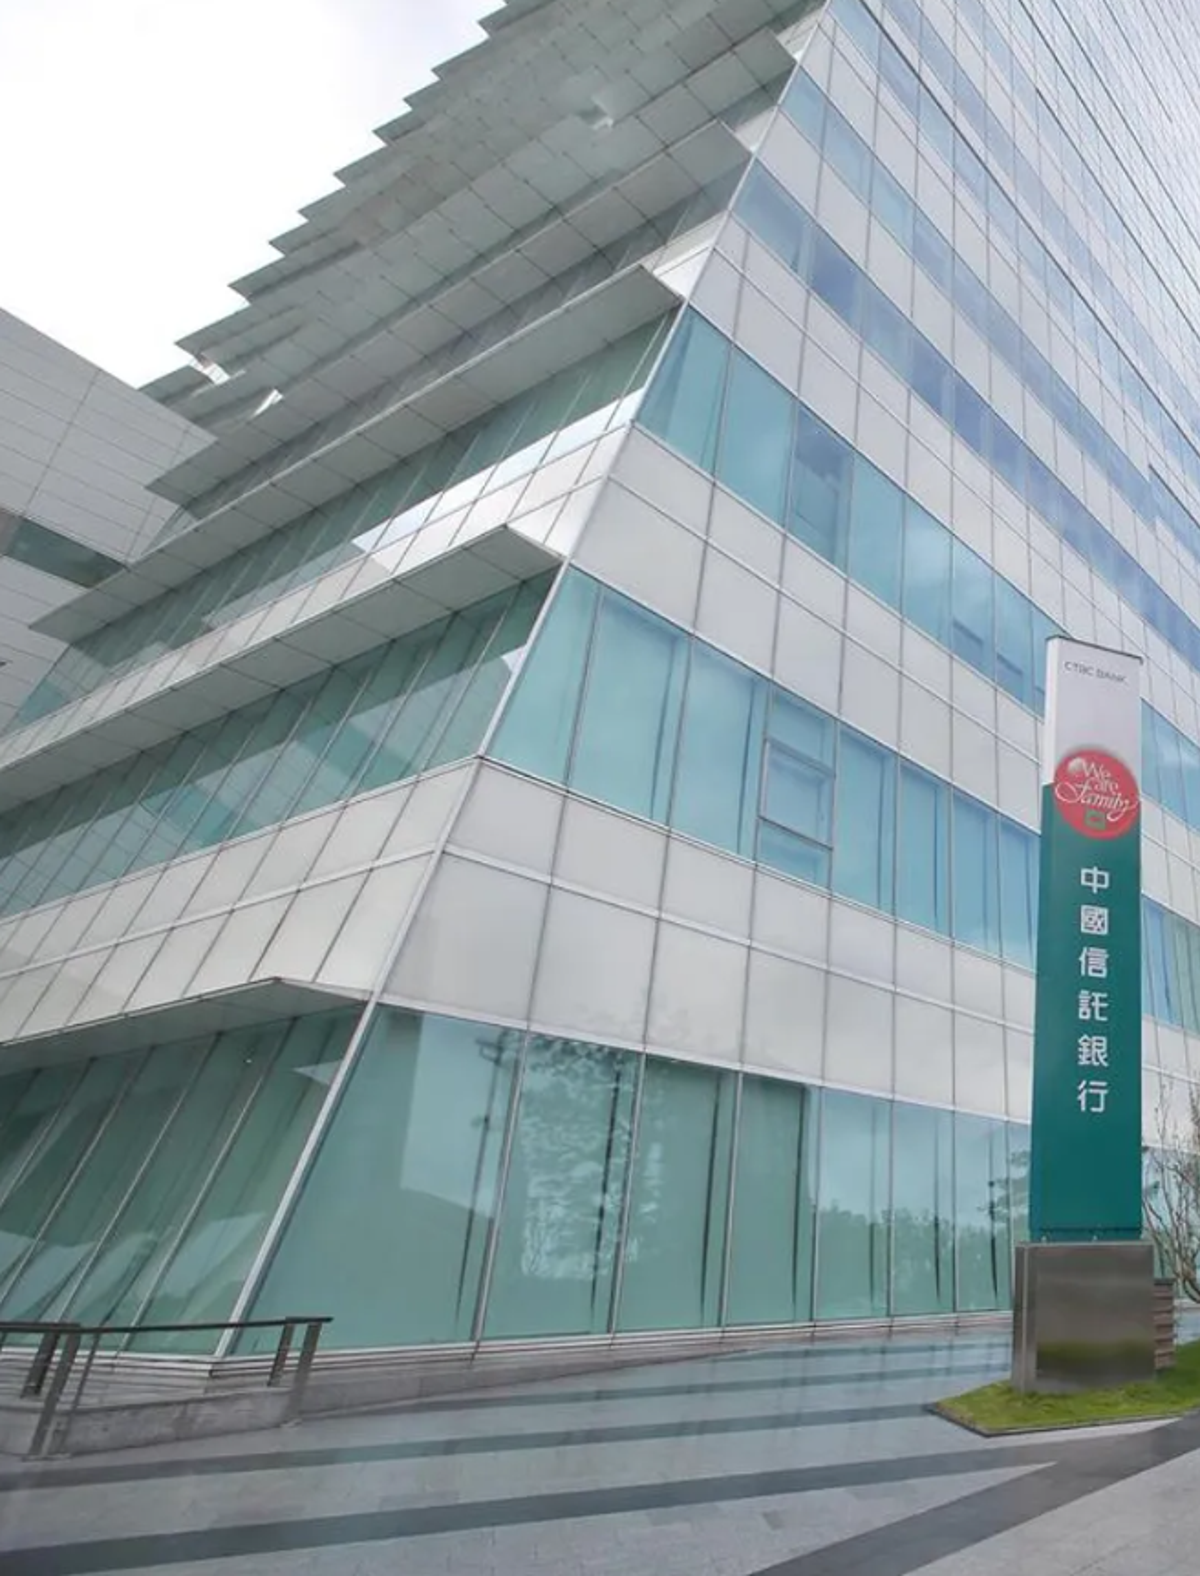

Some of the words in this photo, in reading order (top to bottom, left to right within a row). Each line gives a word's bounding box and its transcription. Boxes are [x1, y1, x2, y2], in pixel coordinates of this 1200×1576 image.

[1064, 661, 1094, 676] CTBC
[1077, 866, 1109, 1112] 中國信託銀行
